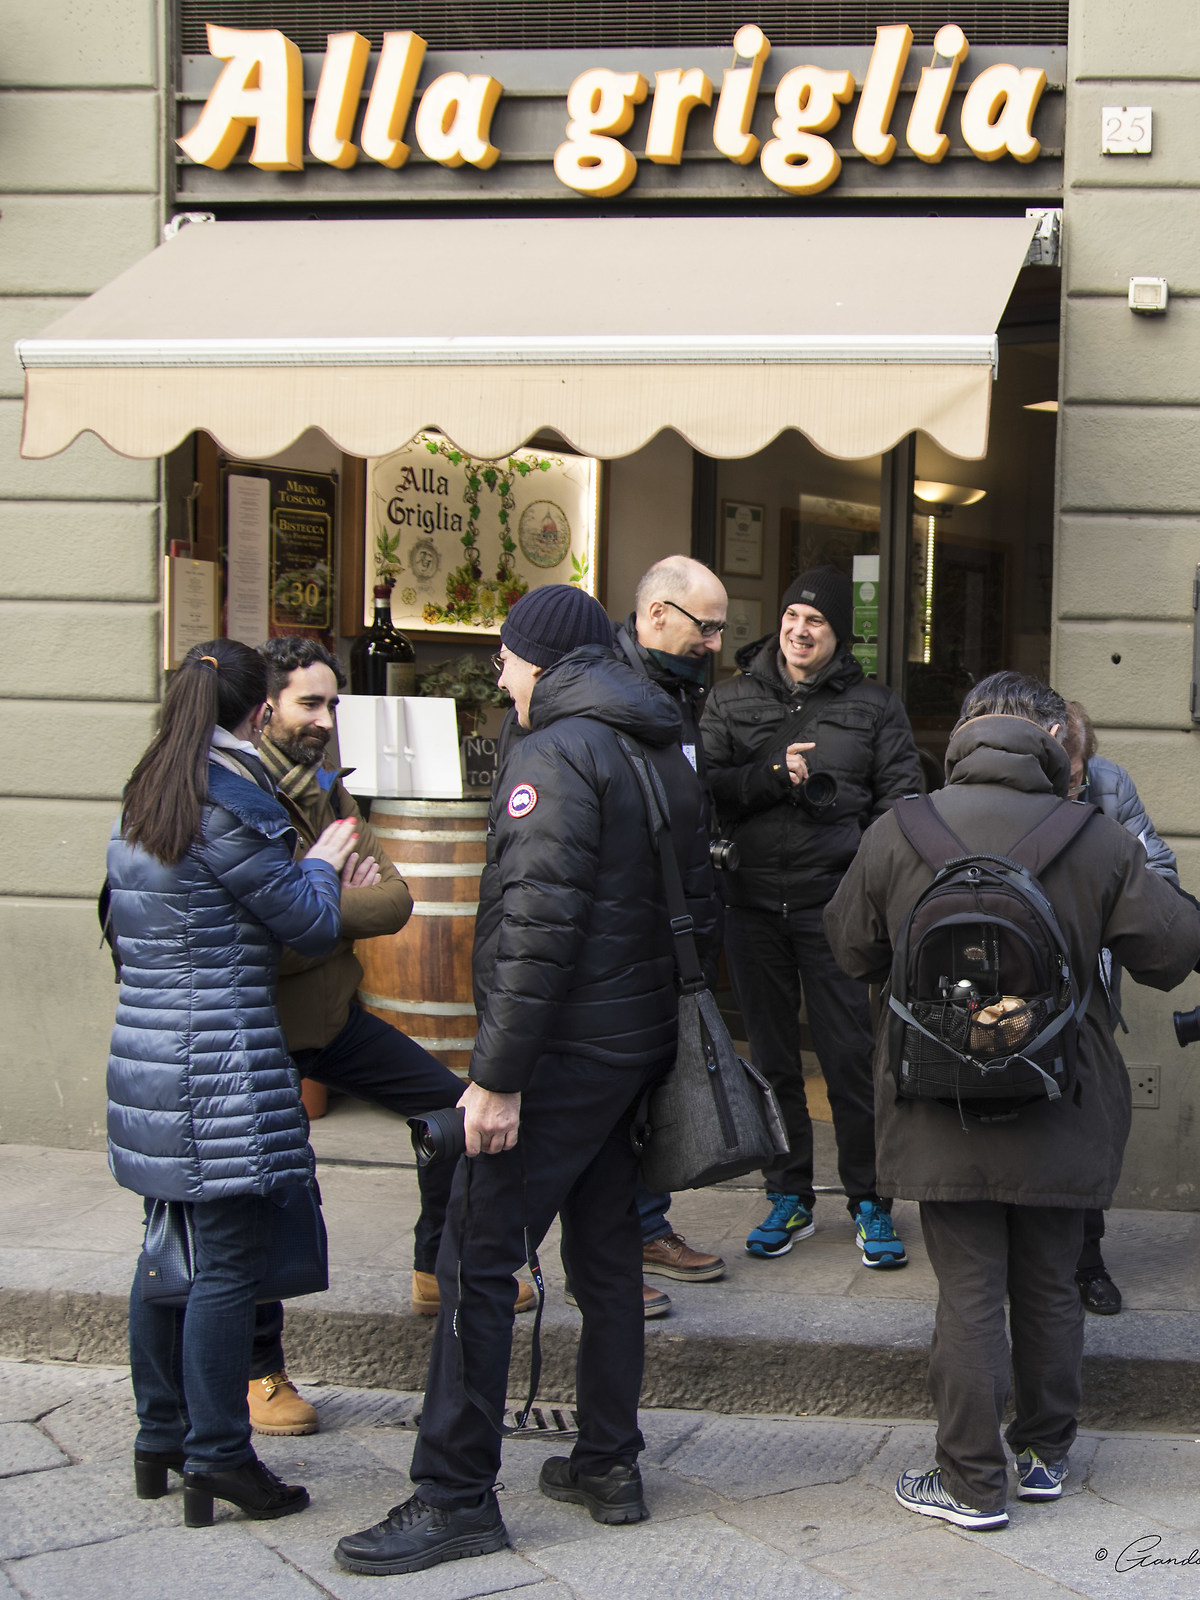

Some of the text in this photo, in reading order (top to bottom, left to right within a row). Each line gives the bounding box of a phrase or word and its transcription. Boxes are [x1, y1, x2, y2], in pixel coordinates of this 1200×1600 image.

[175, 23, 1047, 198] Alla griglia
[1106, 116, 1146, 143] 25
[395, 466, 449, 496] Alla
[386, 496, 463, 534] Griglia
